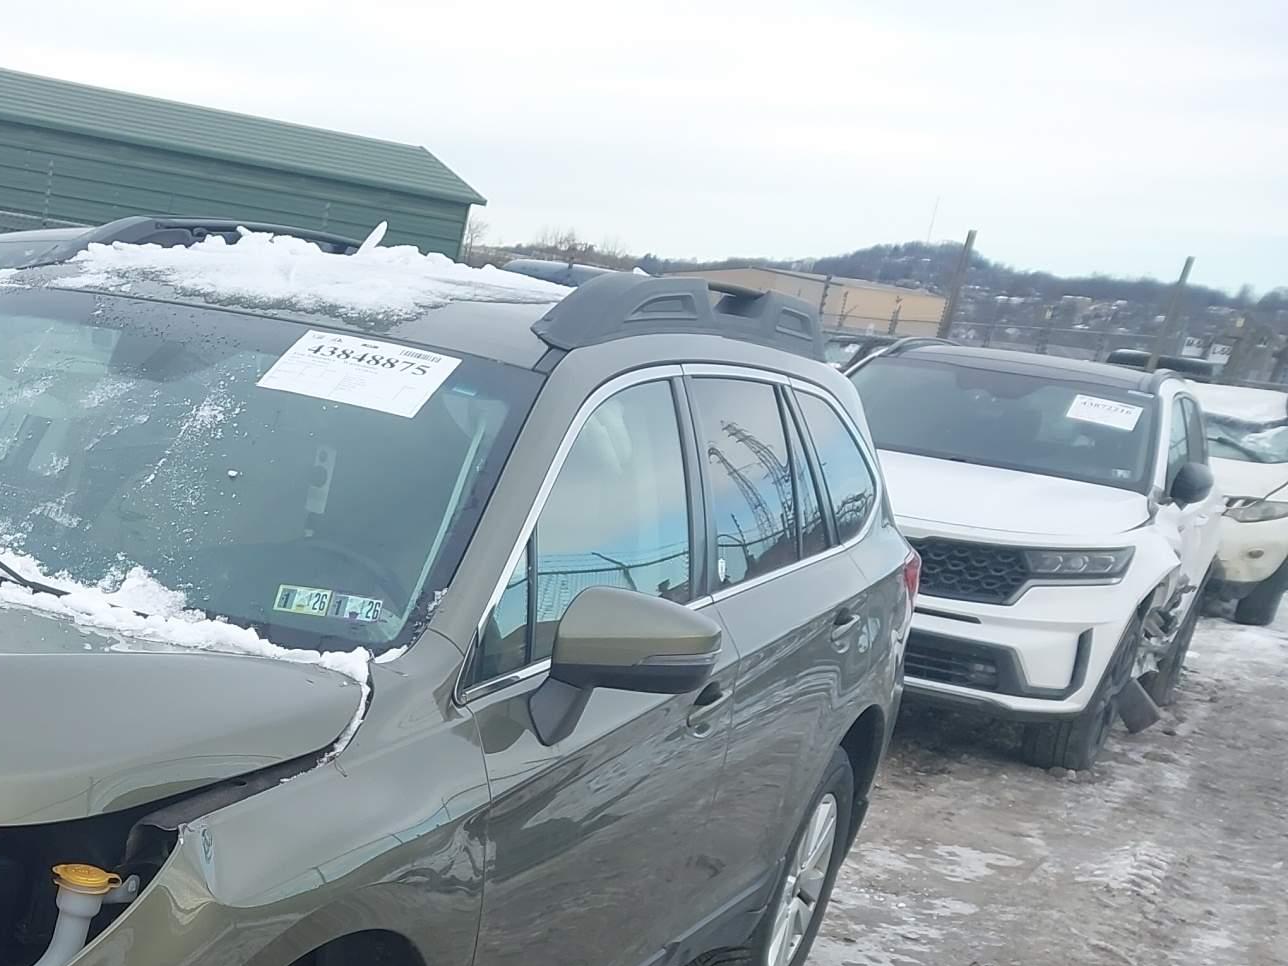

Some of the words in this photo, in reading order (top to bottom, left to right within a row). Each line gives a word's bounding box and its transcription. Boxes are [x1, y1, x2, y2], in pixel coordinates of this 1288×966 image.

[307, 344, 431, 376] 43848875
[311, 592, 328, 611] 26
[365, 600, 381, 620] 26
